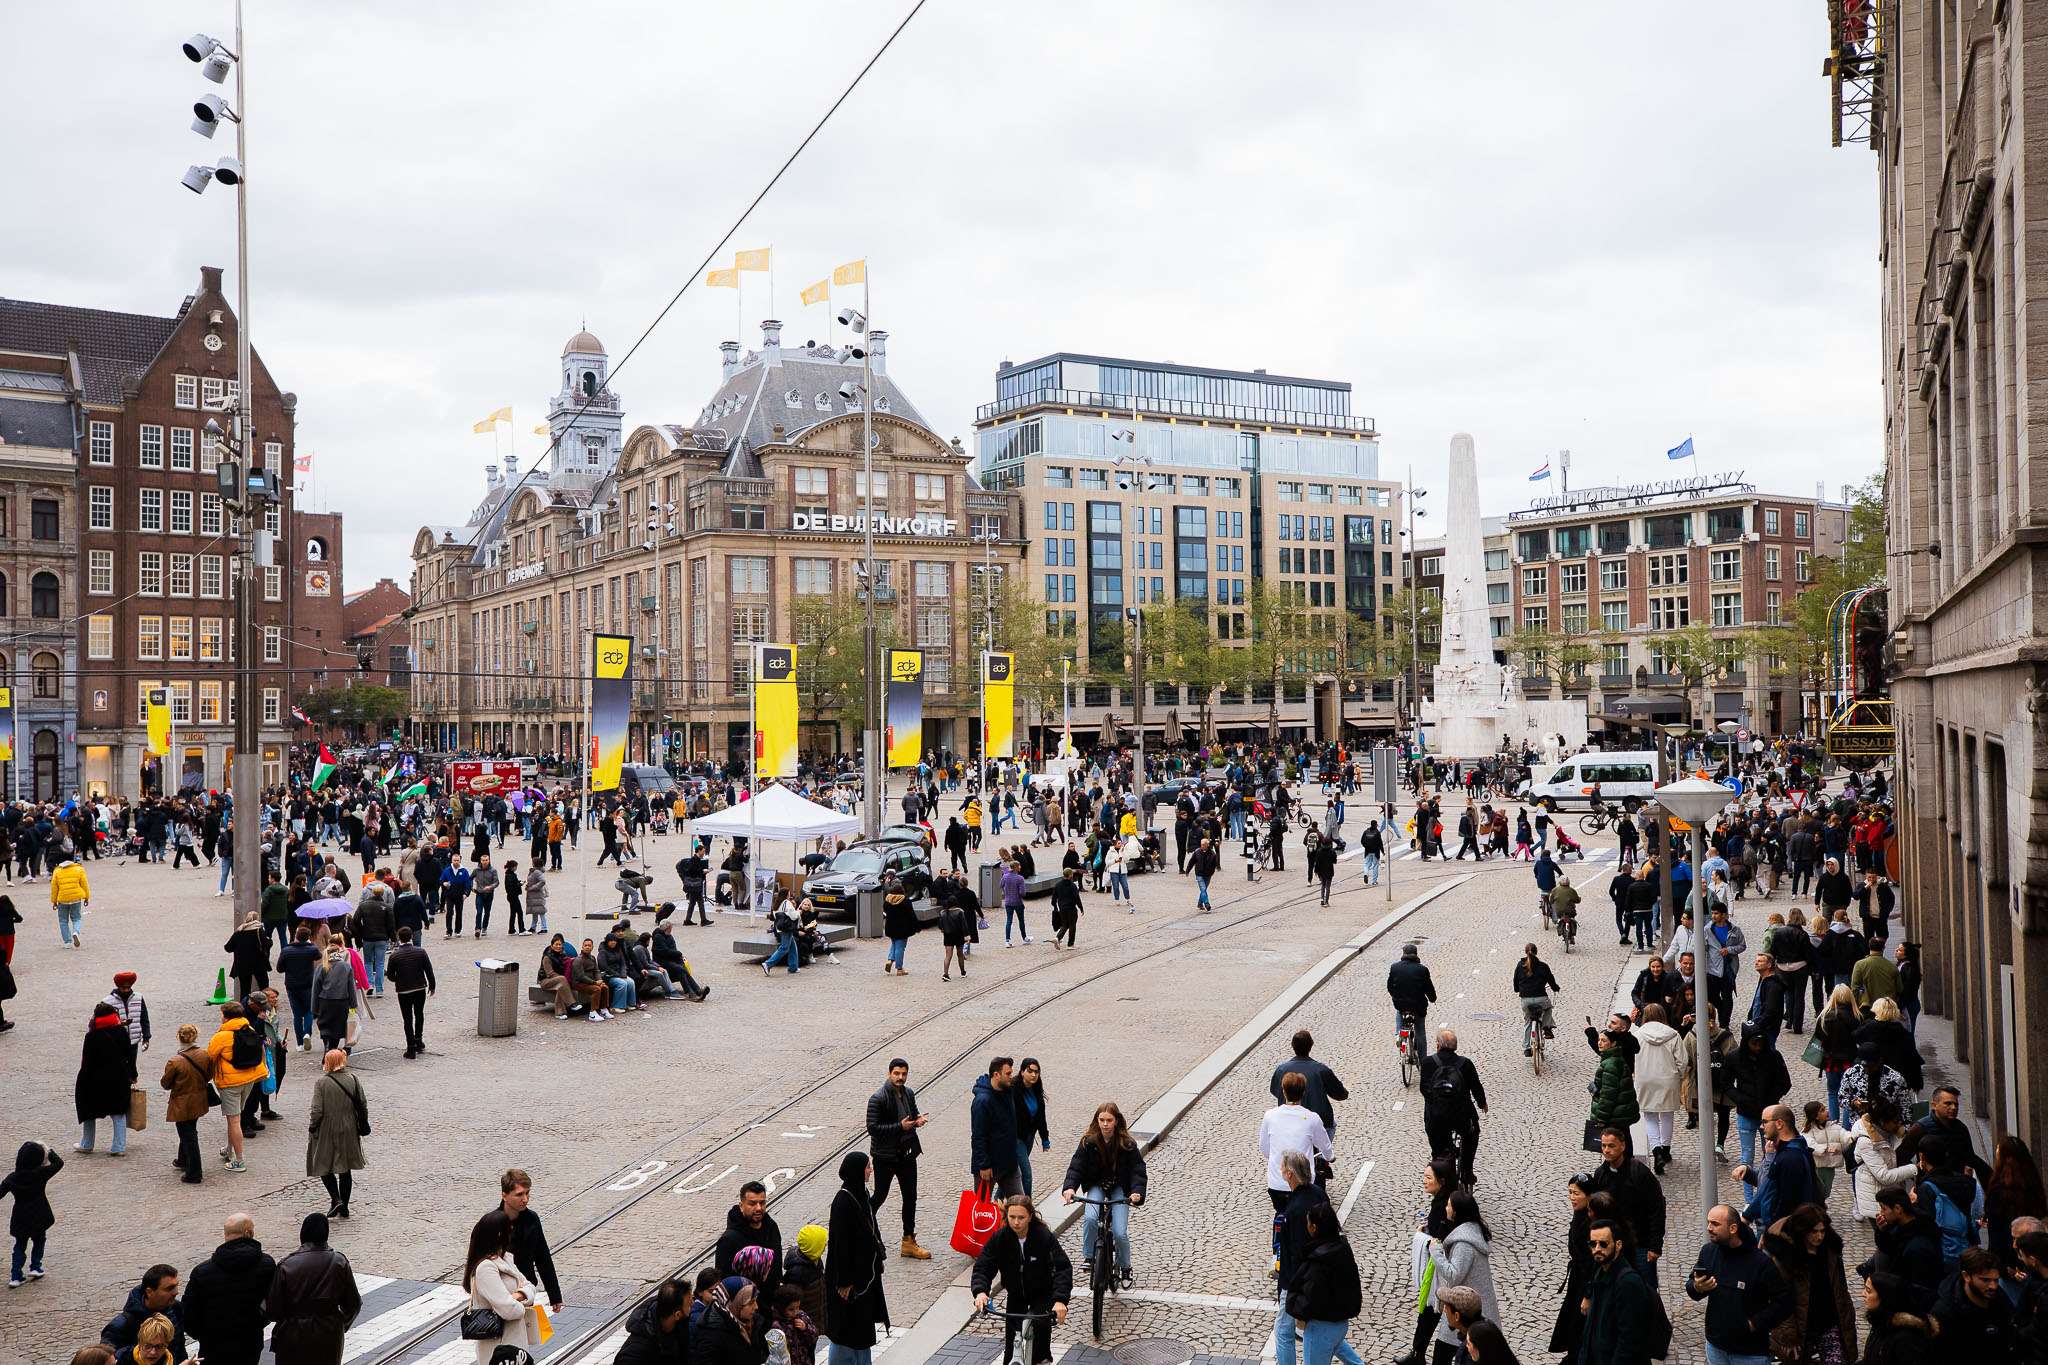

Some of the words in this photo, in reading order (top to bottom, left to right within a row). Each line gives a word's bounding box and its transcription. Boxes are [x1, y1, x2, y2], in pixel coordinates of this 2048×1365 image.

[1530, 494, 1573, 510] GRAND
[1577, 487, 1621, 505] HOTEL
[1627, 470, 1745, 499] KRASNAPOLSKY
[793, 512, 827, 530] DE
[831, 514, 958, 536] BIJENKORF
[1832, 737, 1896, 748] TUSSAUD
[606, 1160, 796, 1198] BUS
